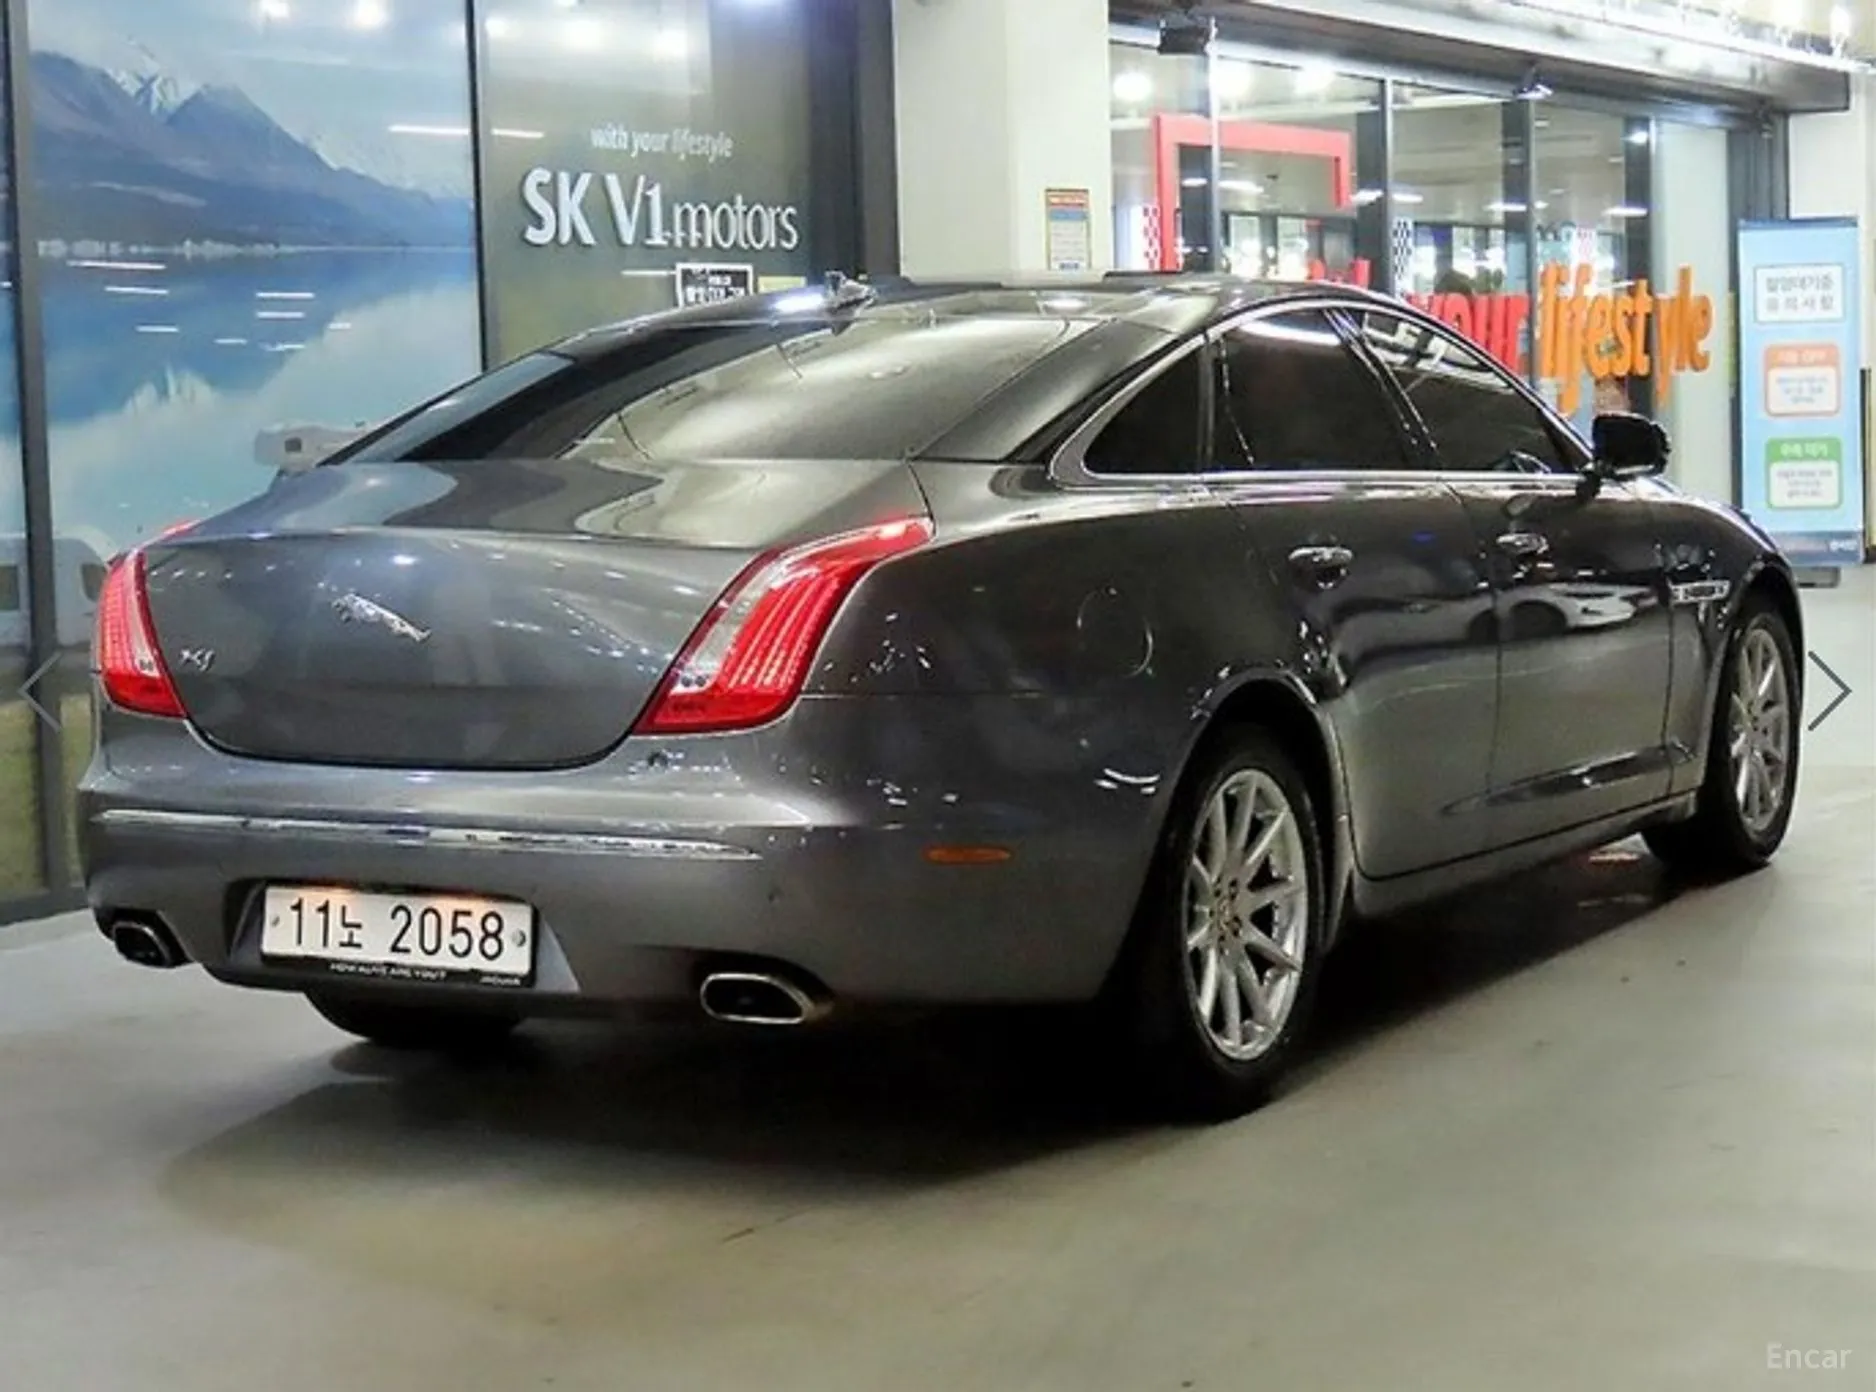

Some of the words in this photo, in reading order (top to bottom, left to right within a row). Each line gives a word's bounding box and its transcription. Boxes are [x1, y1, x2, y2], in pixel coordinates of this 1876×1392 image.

[591, 123, 628, 149] with
[631, 131, 669, 158] your
[671, 128, 733, 163] lifestyle
[523, 167, 596, 246] SK
[1541, 262, 1712, 417] lifestyle
[290, 897, 363, 949] 11노
[390, 905, 504, 961] 2058
